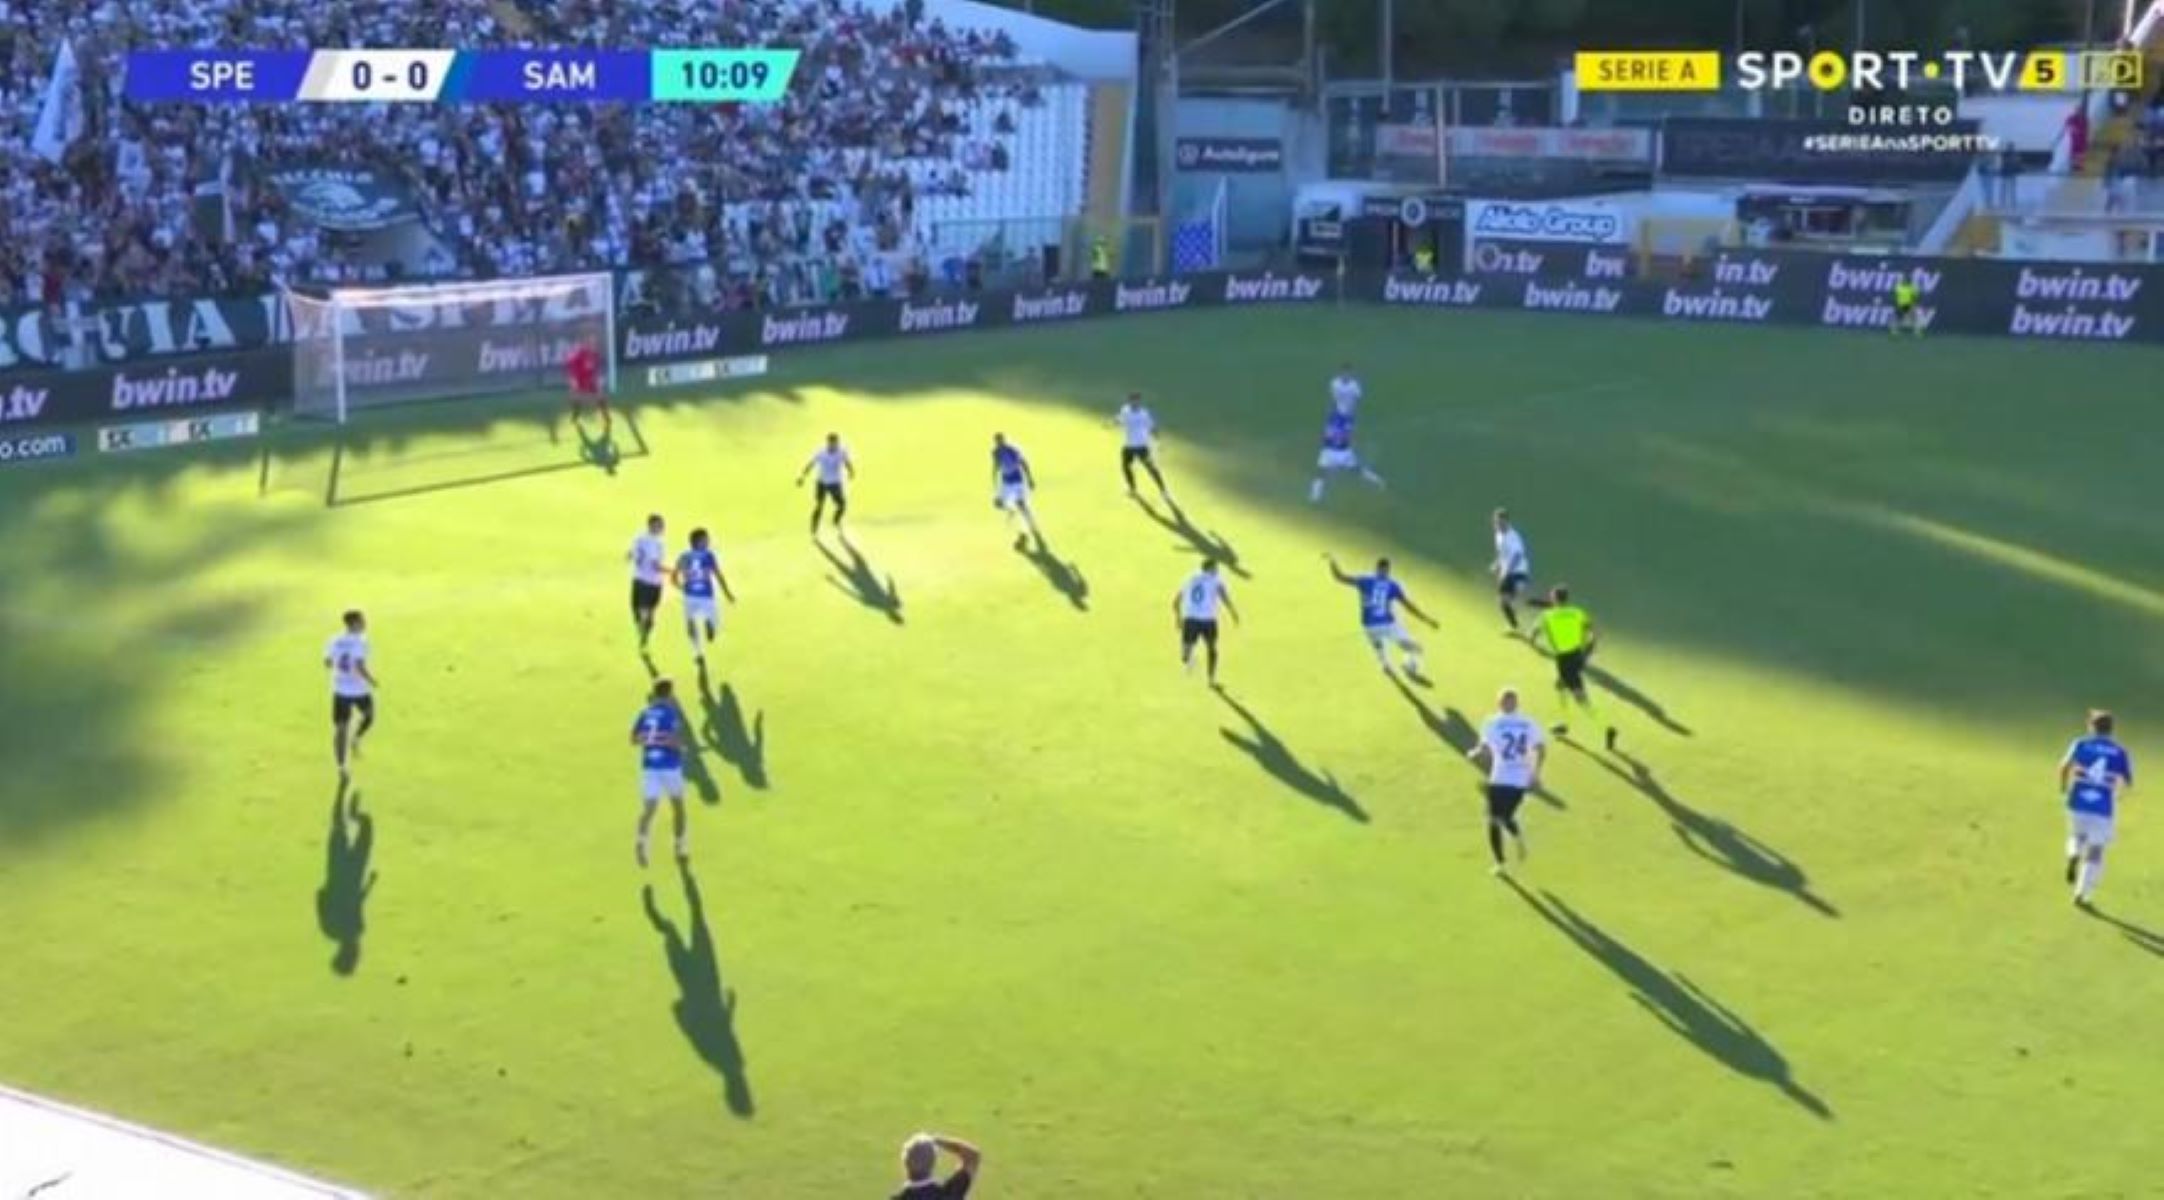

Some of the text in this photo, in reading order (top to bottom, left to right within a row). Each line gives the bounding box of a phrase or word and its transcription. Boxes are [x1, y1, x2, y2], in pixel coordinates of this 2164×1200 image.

[1114, 279, 1190, 310] bwin.tv
[1225, 272, 1322, 300] bwin.tv
[1386, 273, 1482, 304] bwin.tv
[1523, 280, 1622, 312] bwin.tv
[2016, 268, 2141, 300] bwin.tv
[900, 296, 979, 331] bwin.tv
[1012, 289, 1086, 320] bwin.tv
[1663, 289, 1771, 321] bwin.tv
[2010, 304, 2135, 337] bwin.tv
[624, 321, 719, 359] bwin.tv
[761, 309, 848, 344] bwin.tv
[111, 366, 237, 410] bwin.tv
[1501, 731, 1528, 760] 24
[2088, 757, 2106, 785] 4
